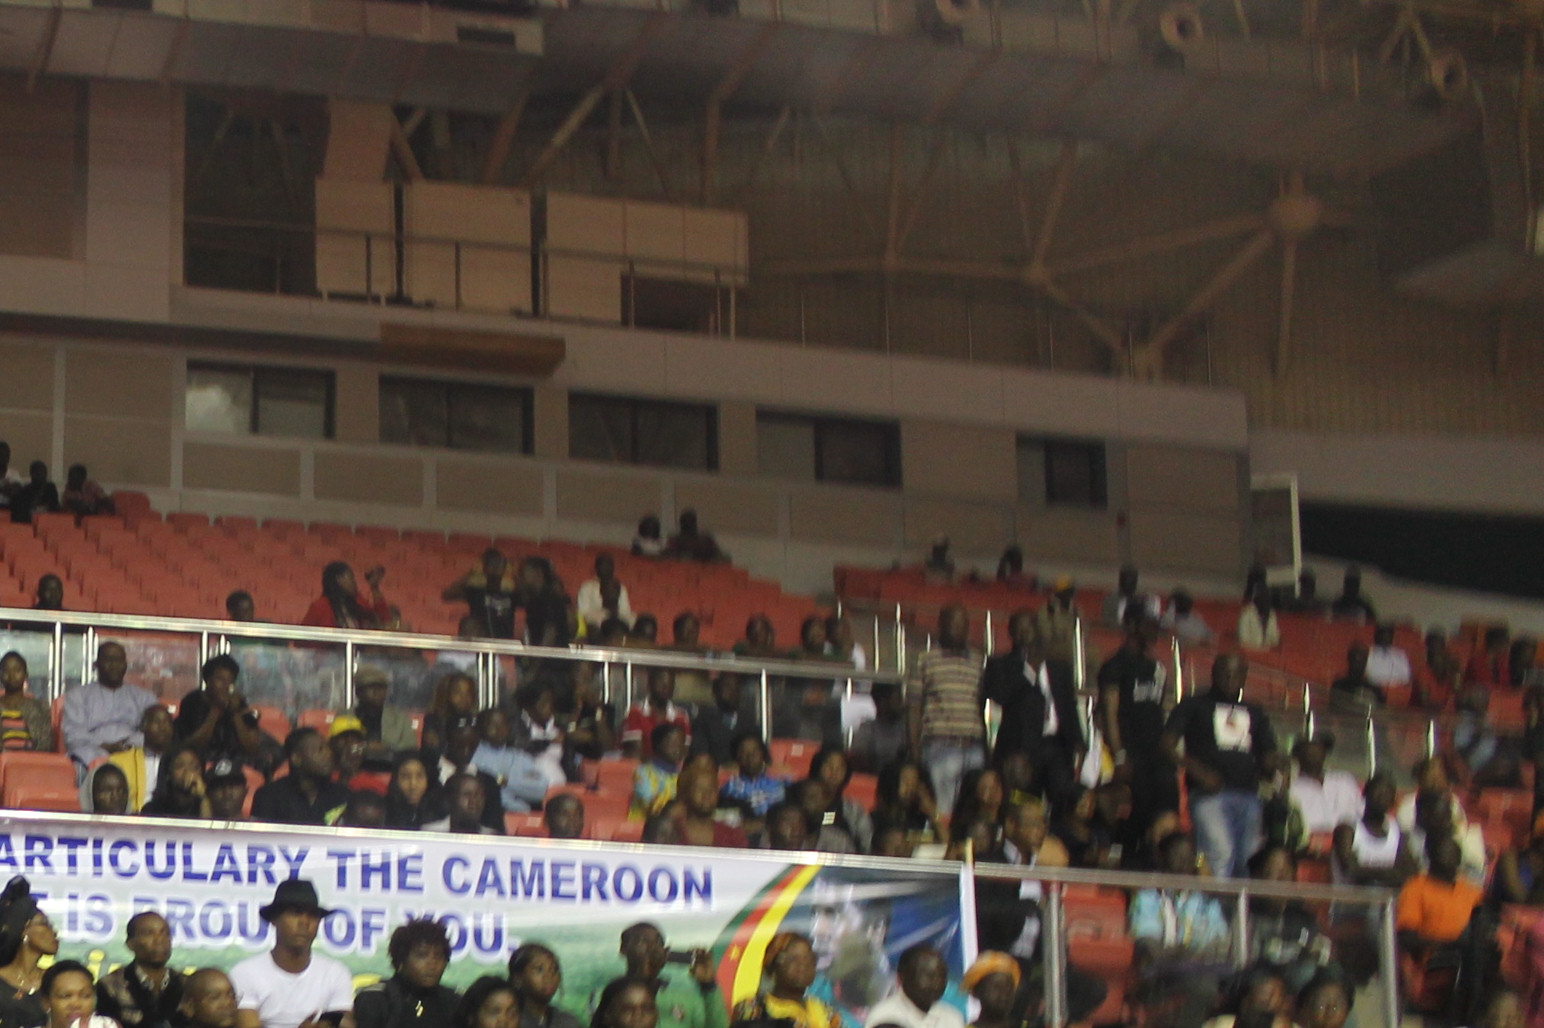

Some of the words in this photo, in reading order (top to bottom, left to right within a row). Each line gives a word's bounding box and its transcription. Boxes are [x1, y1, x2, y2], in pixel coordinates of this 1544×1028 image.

[327, 844, 423, 894] THE
[442, 855, 713, 909] CAMEROON
[68, 894, 113, 933] IS
[133, 897, 270, 942] ROU
[324, 909, 385, 949] OF
